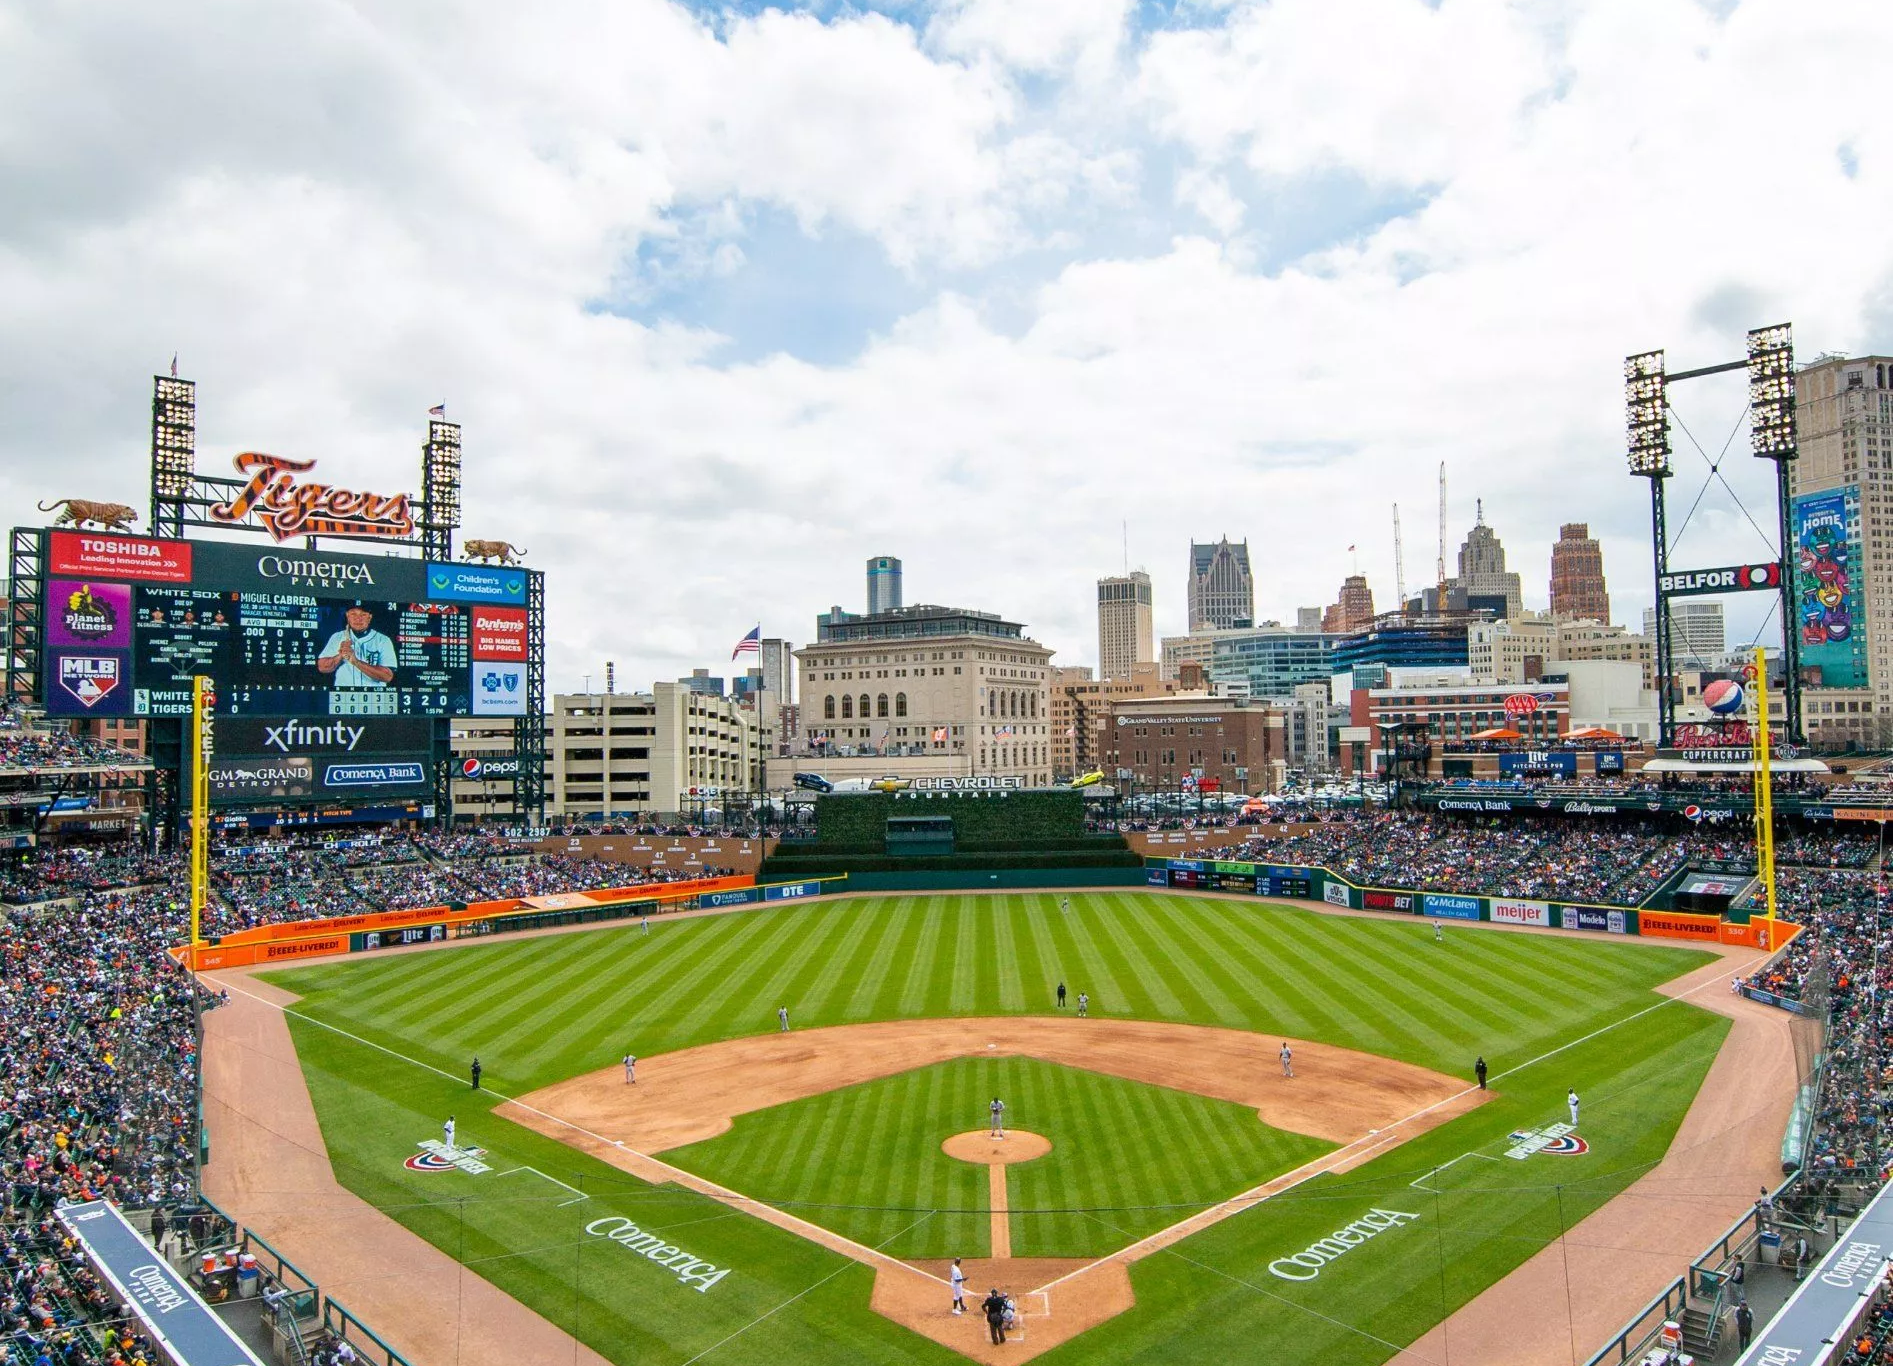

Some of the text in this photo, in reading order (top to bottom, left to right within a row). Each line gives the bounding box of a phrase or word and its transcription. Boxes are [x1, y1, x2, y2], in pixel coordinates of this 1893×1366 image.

[209, 451, 414, 543] Tigers
[80, 540, 161, 556] TOSHIBA
[80, 554, 161, 566] Leading Innovation
[291, 577, 345, 589] PARK
[457, 574, 499, 585] Children's
[1660, 570, 1735, 591] BELFOR
[146, 588, 220, 599] WHITE SOX
[454, 584, 502, 596] Foundation
[240, 593, 316, 606] MIGUEL CABRERA
[388, 602, 396, 610] 24
[66, 613, 105, 624] planet
[476, 618, 524, 630] Dunham's
[71, 621, 113, 632] fitness
[243, 628, 264, 636] .000
[64, 659, 115, 673] MLB
[152, 692, 190, 701] WHITE
[403, 696, 411, 705] 3
[422, 696, 429, 705] 2
[440, 696, 447, 706] 0
[152, 704, 192, 714] TIGERS
[231, 705, 238, 713] 0
[1506, 696, 1538, 713] AAA
[264, 719, 365, 752] xfinity
[1529, 751, 1549, 764] Lite
[1683, 751, 1753, 760] COPPERCRAFT
[389, 767, 416, 778] Bank
[482, 760, 519, 775] pepsi
[201, 768, 309, 781] GM GRAND
[217, 780, 288, 788] DETROIT
[915, 777, 1023, 790] CHEVROLET
[1485, 801, 1511, 811] Bank
[1564, 801, 1594, 815] Bally
[1702, 809, 1732, 819] pepsi
[90, 820, 126, 829] MARKET
[505, 828, 522, 836] 502
[529, 828, 551, 836] 2987
[323, 840, 383, 849] CHEVROLET
[225, 846, 290, 856] CHEVROLET
[783, 885, 804, 897] DTE
[1326, 894, 1347, 905] VISION
[1364, 893, 1411, 908] POINTSBET
[1439, 897, 1476, 909] McLaren
[416, 909, 445, 919] DELIVERY
[1496, 903, 1541, 922] meijer
[333, 918, 365, 927] DELIVERY
[1579, 913, 1606, 925] Modelo
[403, 929, 423, 942] Lite
[1854, 1254, 1881, 1280] PARK
[128, 1281, 155, 1305] PARK
